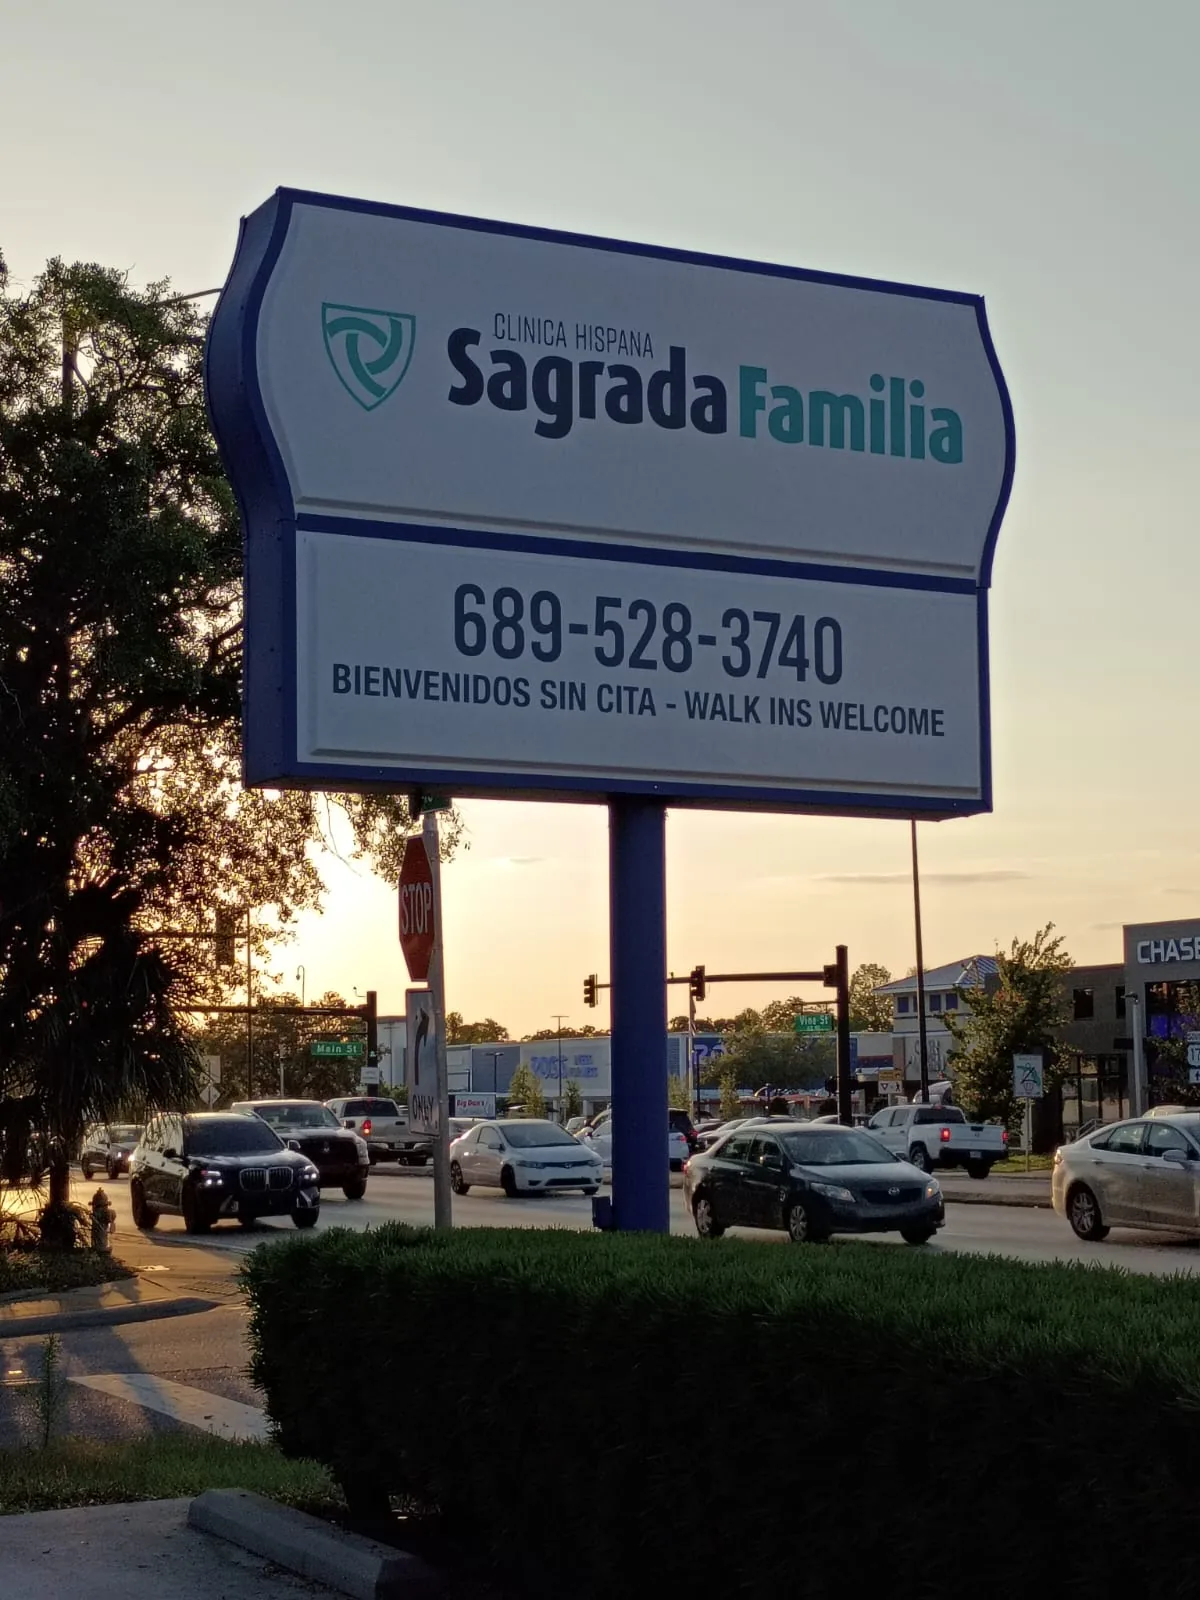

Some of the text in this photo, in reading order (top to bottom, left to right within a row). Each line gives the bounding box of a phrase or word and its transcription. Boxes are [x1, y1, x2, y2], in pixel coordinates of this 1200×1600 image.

[493, 312, 655, 359] CLINICA HISPANA
[447, 327, 964, 465] Sagrada Familia
[454, 583, 843, 685] 689-528-3740
[332, 663, 531, 708] BIENVENIDOS
[540, 680, 587, 712] SIN
[596, 683, 657, 717] CITA
[684, 690, 762, 725] WALK
[769, 697, 813, 728] INS
[819, 700, 945, 737] WELCOME
[402, 882, 432, 935] STOP
[1137, 937, 1200, 964] CHASE
[820, 1015, 829, 1025] St
[317, 1044, 357, 1054] Main St
[412, 1095, 434, 1121] ONLY
